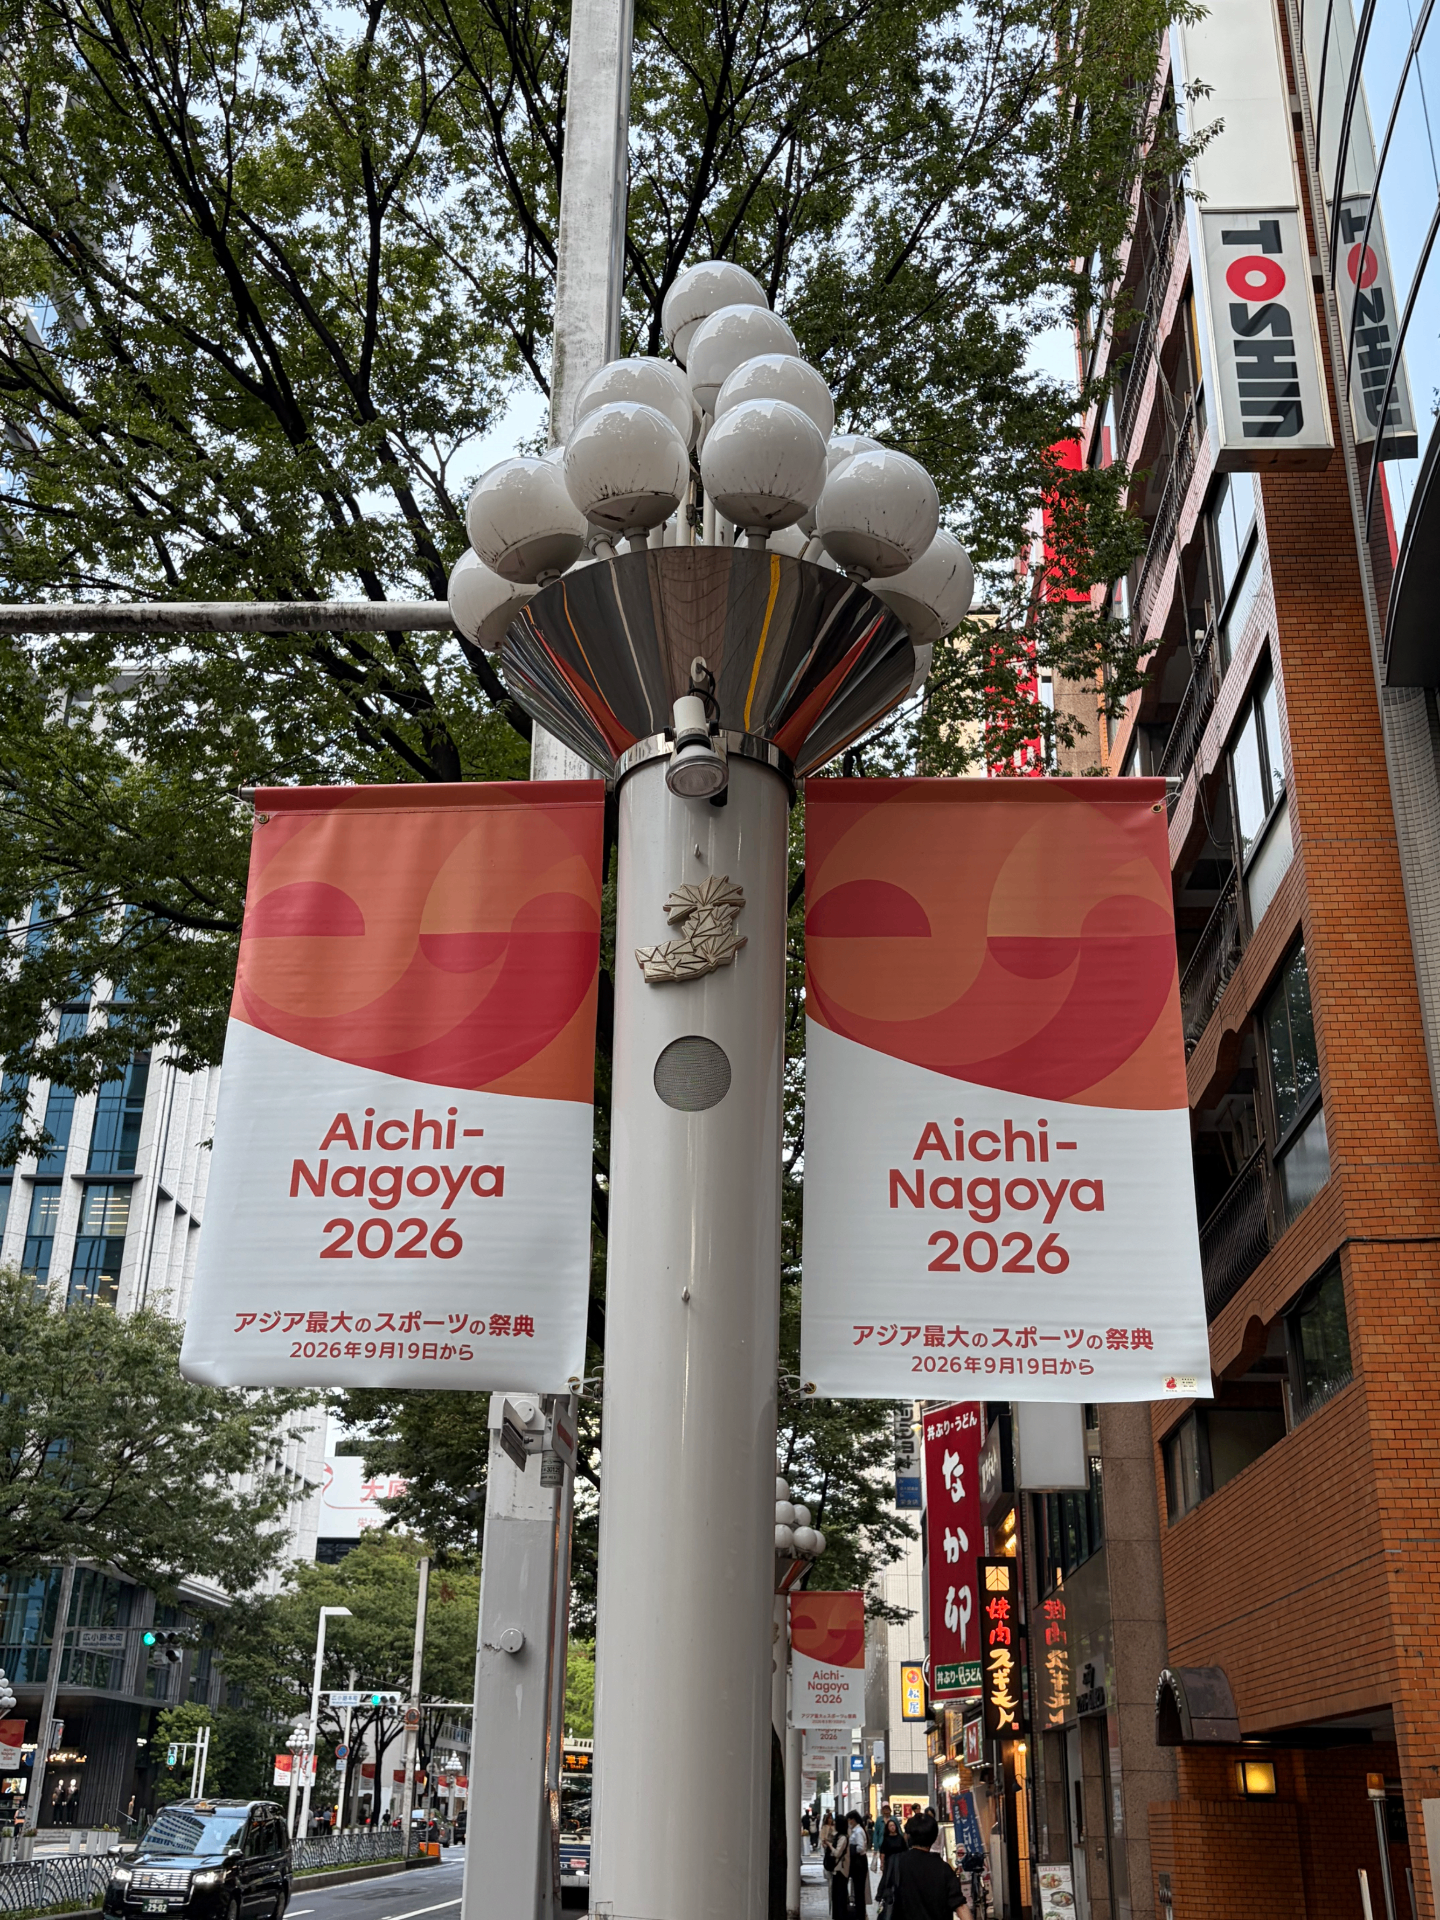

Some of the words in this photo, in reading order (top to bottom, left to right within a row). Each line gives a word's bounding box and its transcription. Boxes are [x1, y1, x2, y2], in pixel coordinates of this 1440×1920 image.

[1221, 219, 1304, 438] TOSHIN
[318, 1107, 484, 1151] Aichi-
[912, 1117, 1077, 1163] Aichi-
[289, 1158, 505, 1211] Nagoya
[889, 1169, 1105, 1224] Nagoya
[319, 1218, 464, 1260] 2026
[927, 1230, 1070, 1275] 2026
[233, 1310, 536, 1338] アジア最大のスポーツの祭典
[852, 1324, 1154, 1351] アジア最大のスポーツの祭典
[289, 1340, 475, 1361] 2026年9月19日から
[911, 1355, 1095, 1376] 2026年9月19日から
[927, 1411, 978, 1441] 丼ぶり・うどん
[941, 1448, 972, 1654] なか卯
[812, 1669, 845, 1681] Aichi-
[983, 1596, 1019, 1730] 焼肉スギモト
[807, 1680, 849, 1693] Nagoya
[815, 1694, 843, 1704] 2026
